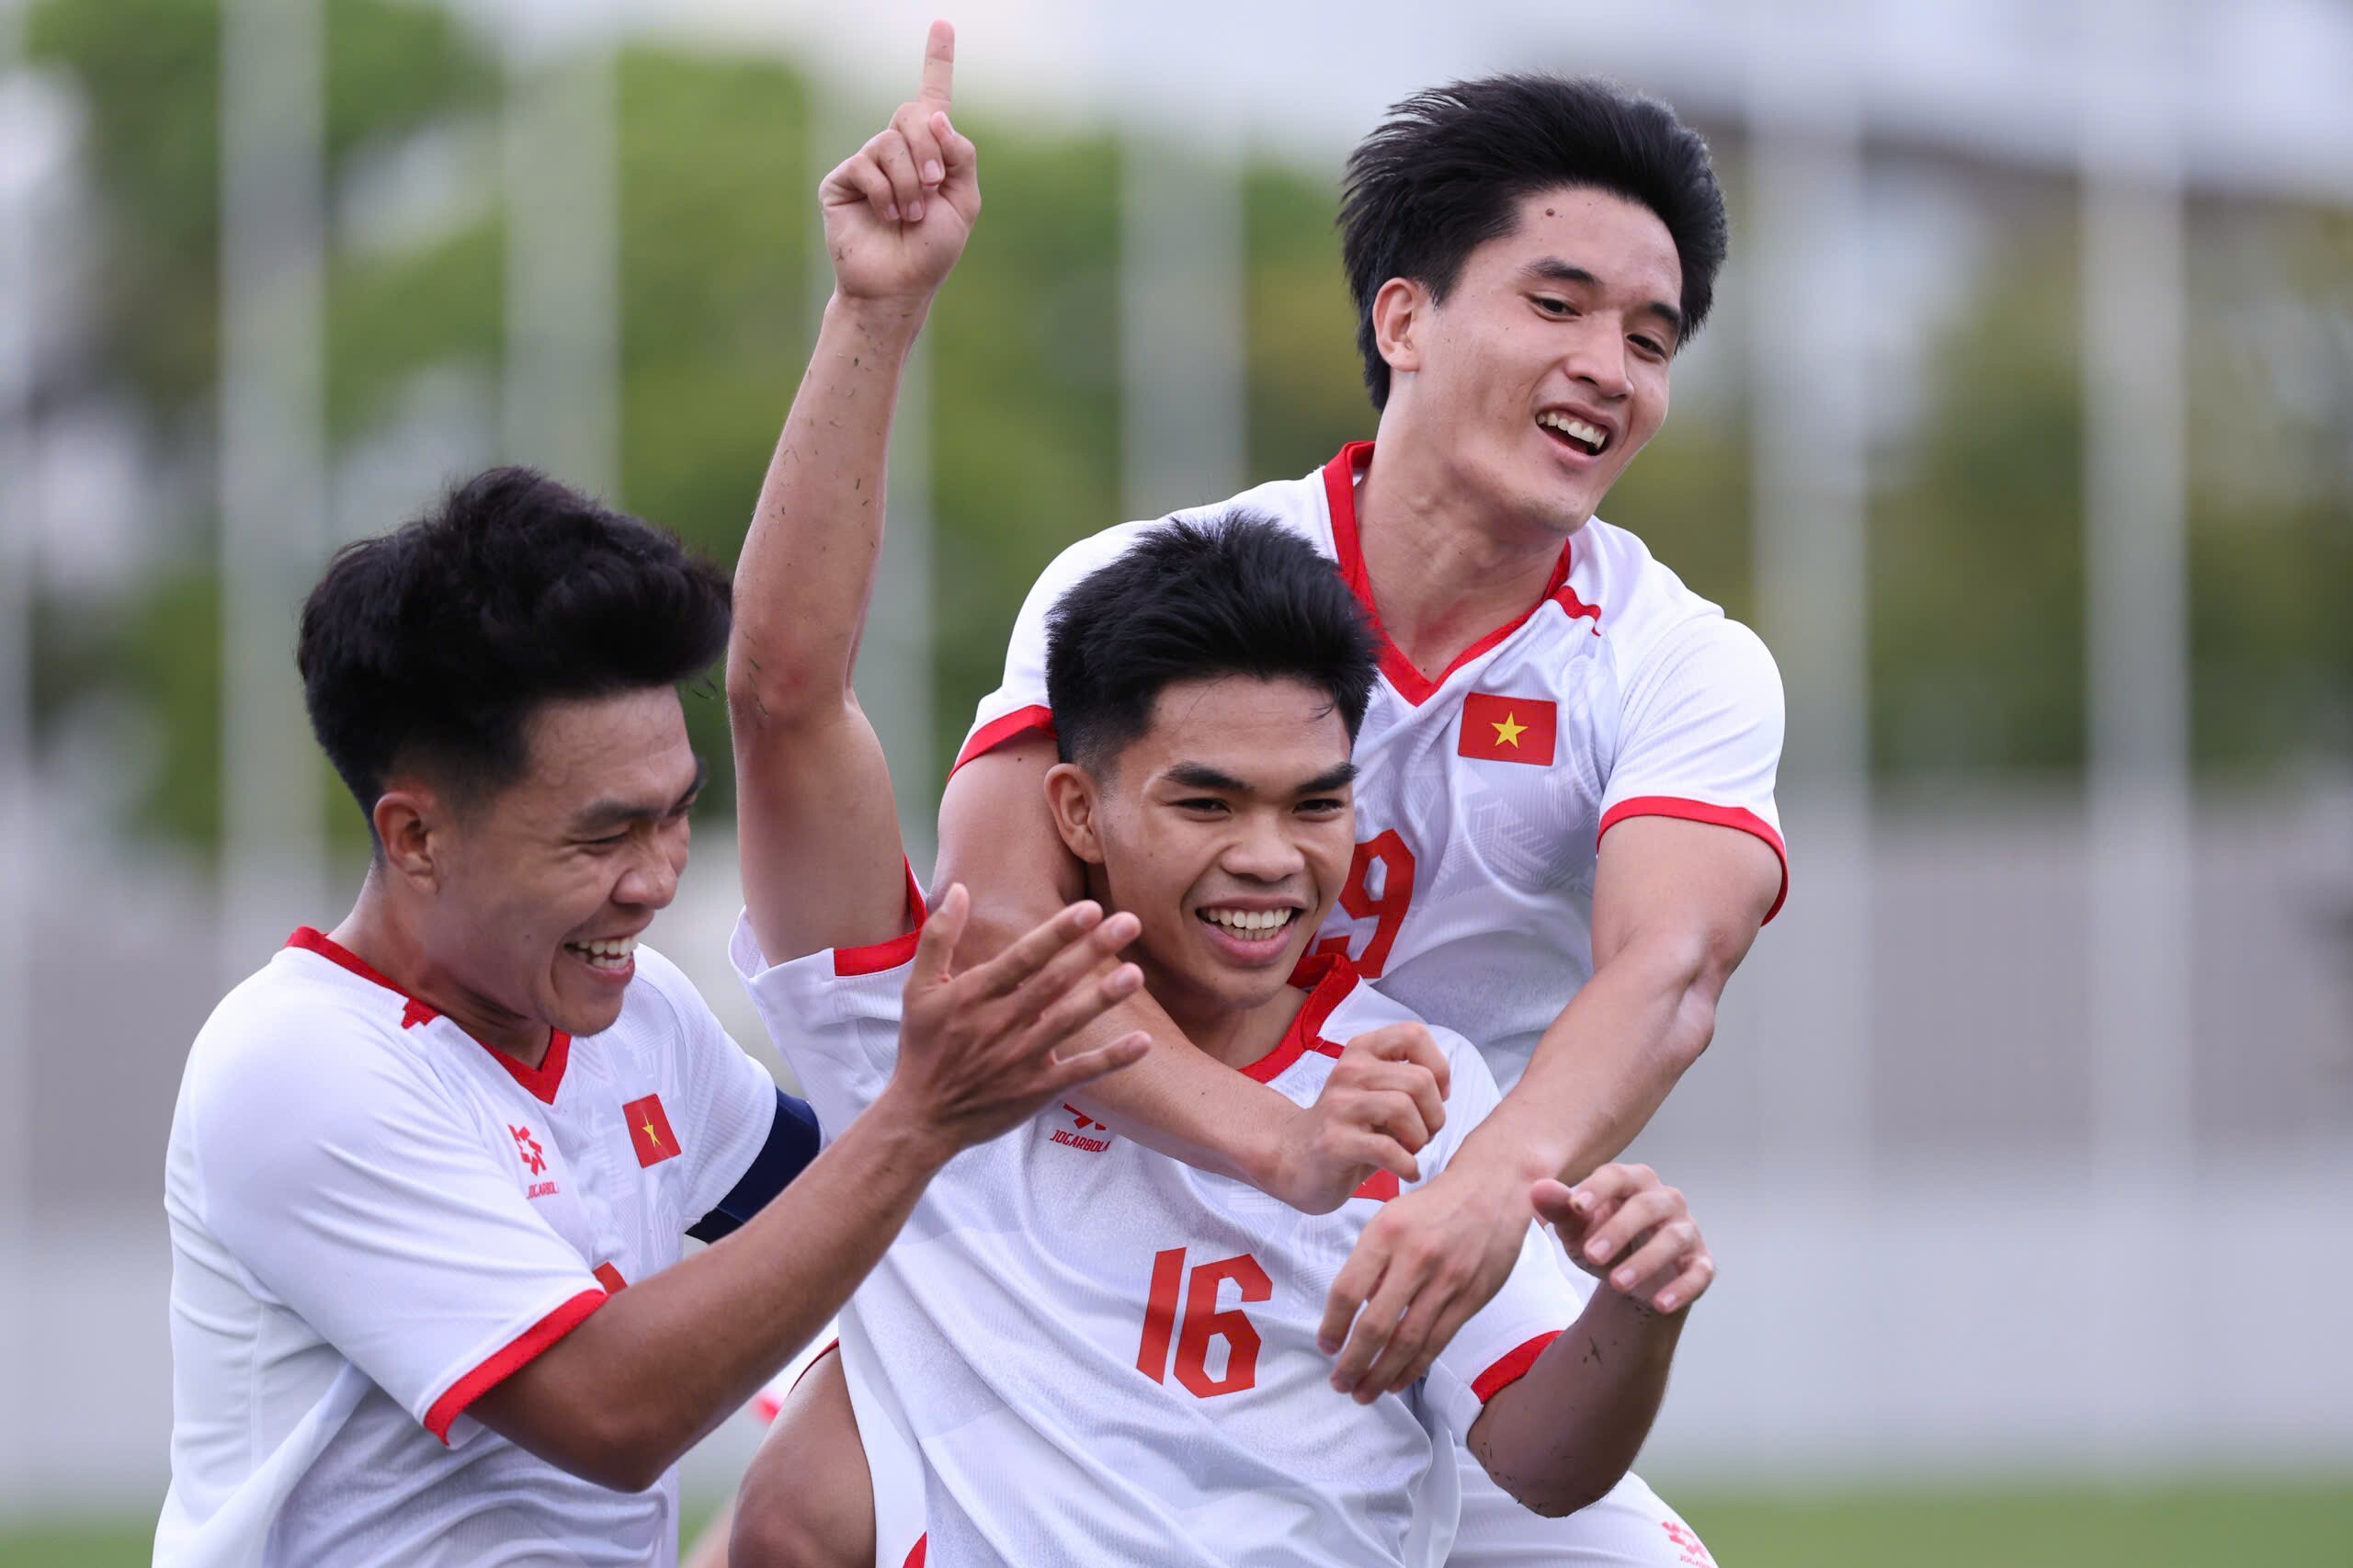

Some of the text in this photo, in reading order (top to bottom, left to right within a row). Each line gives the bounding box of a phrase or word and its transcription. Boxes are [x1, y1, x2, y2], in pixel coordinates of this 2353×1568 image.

[1305, 828, 1415, 979] 9
[1050, 1129, 1110, 1153] JOGARBOLA
[1136, 1247, 1273, 1399] 16
